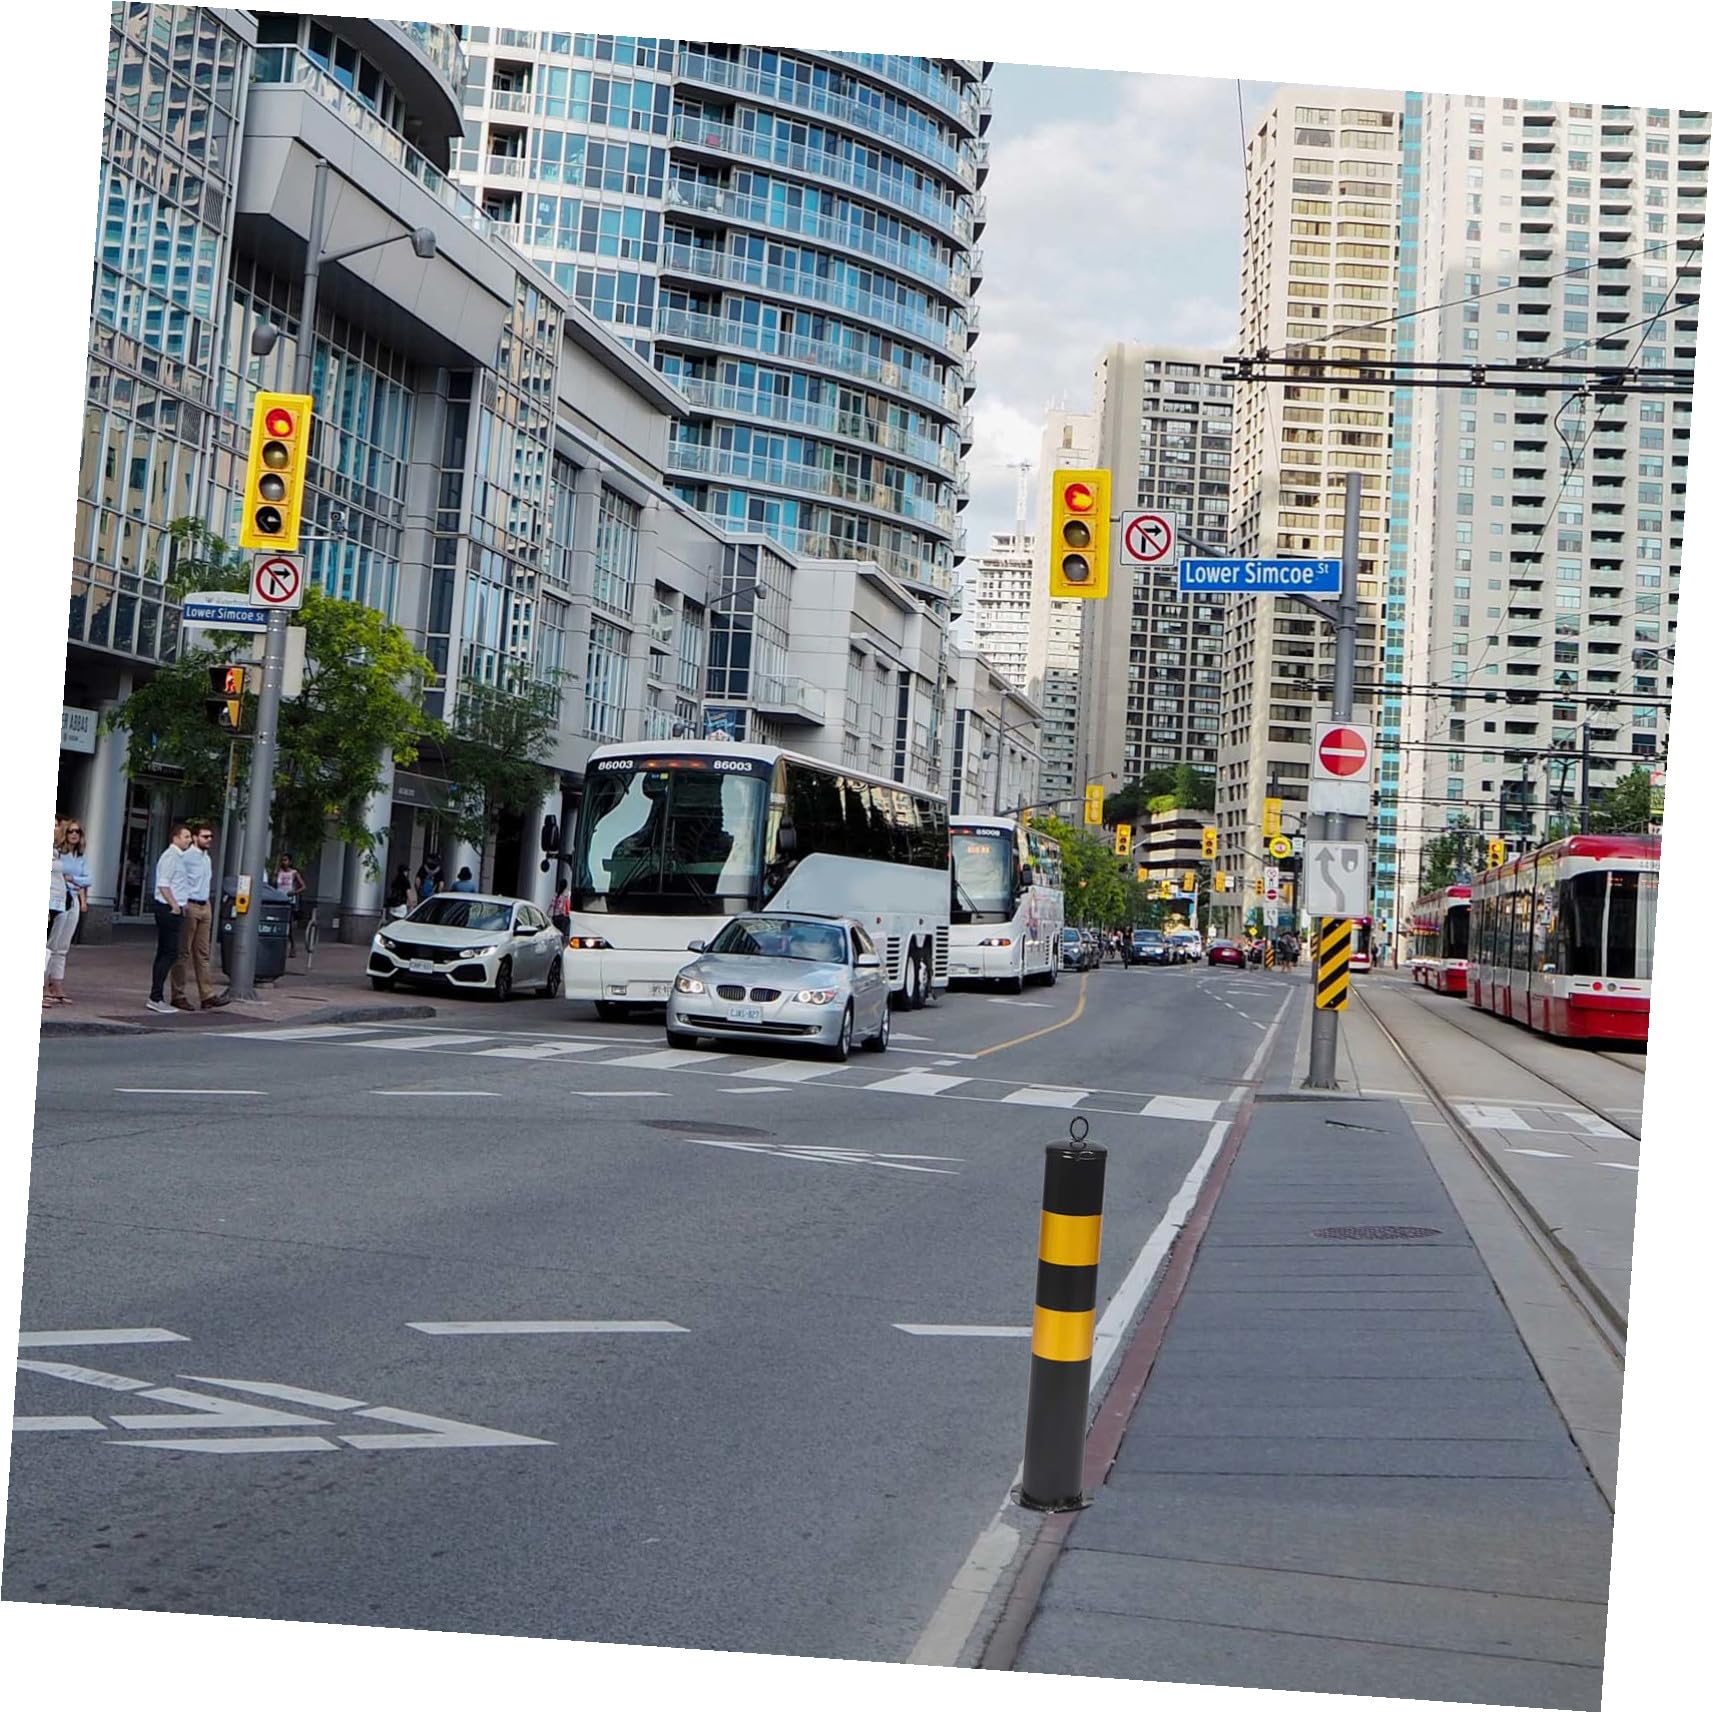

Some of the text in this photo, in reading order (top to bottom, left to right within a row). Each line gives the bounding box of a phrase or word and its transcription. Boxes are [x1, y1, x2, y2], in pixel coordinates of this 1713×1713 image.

[1185, 562, 1329, 585] Lower Simcoe St
[186, 606, 264, 622] Lower Simcoe St
[598, 760, 634, 771] 86003
[713, 760, 753, 772] 86003
